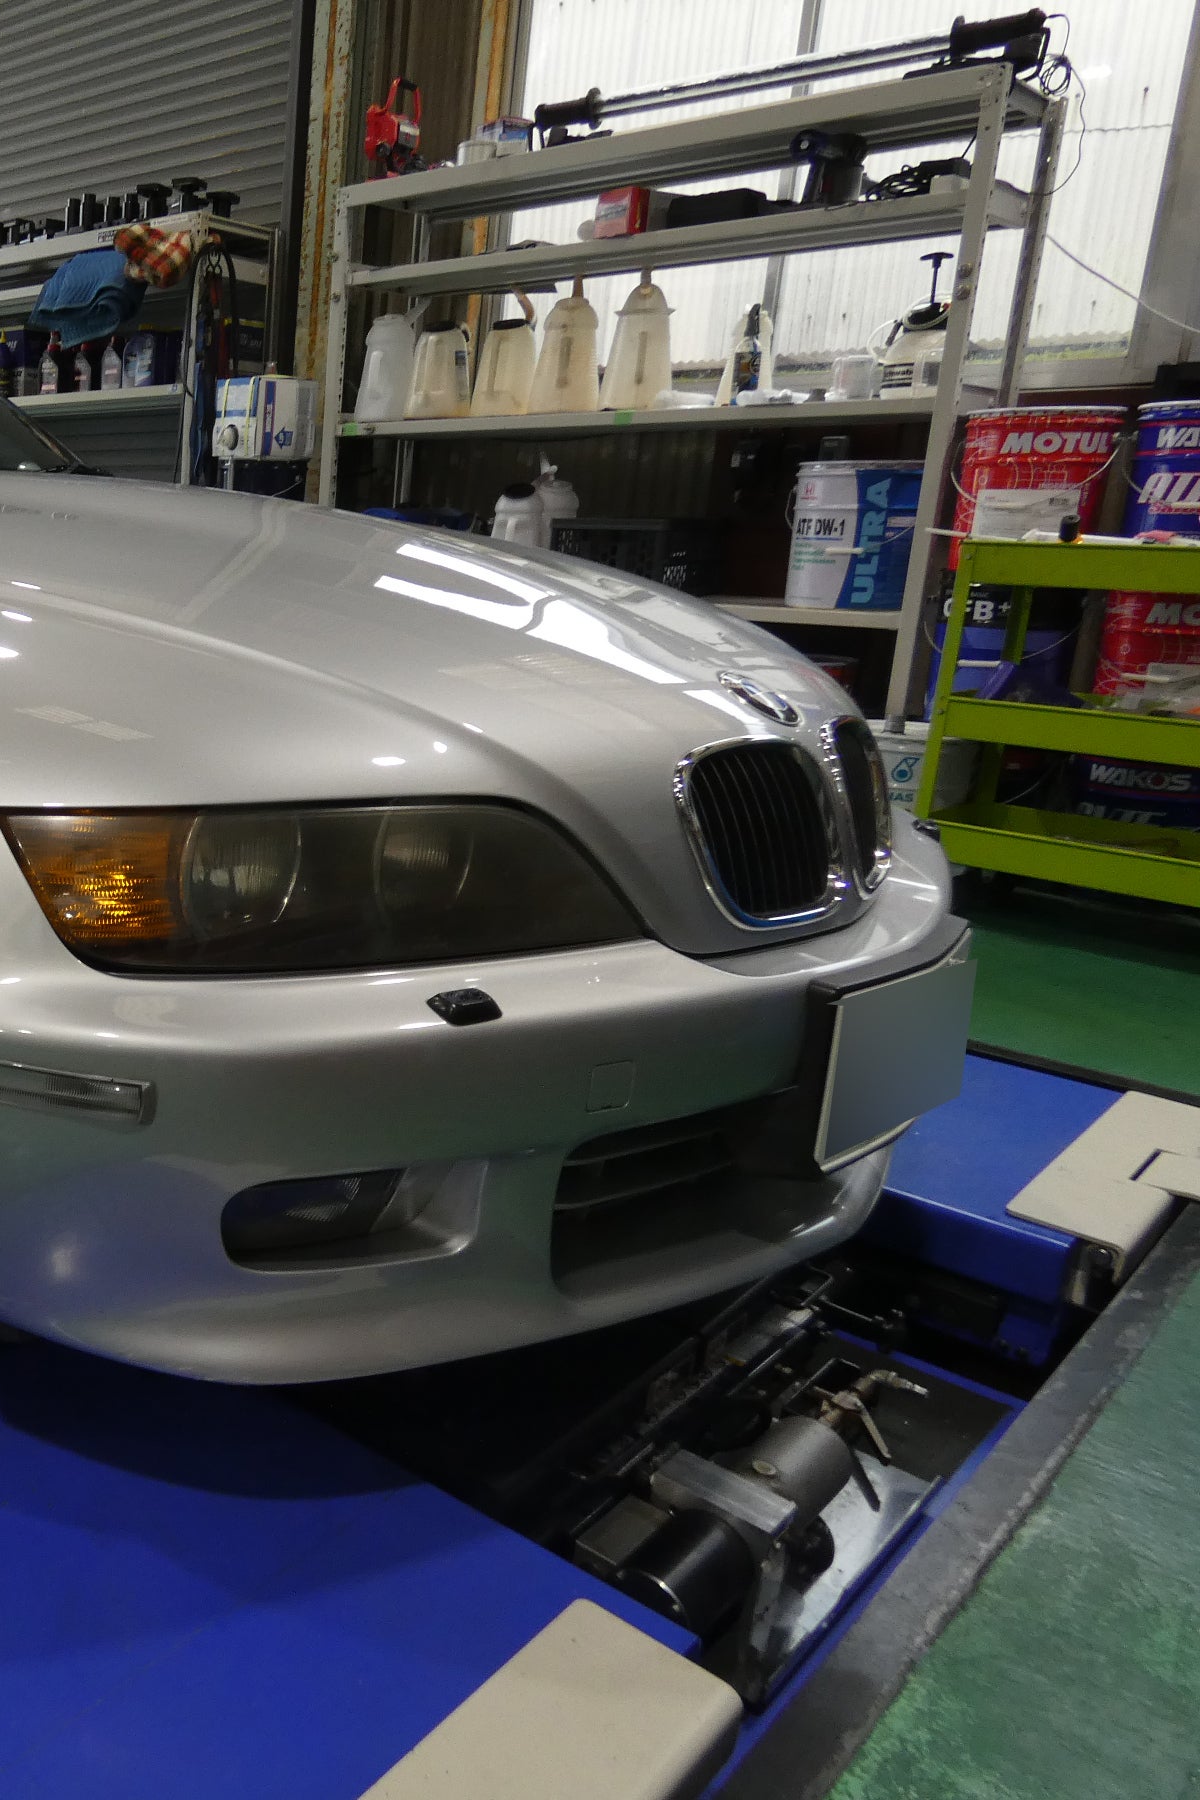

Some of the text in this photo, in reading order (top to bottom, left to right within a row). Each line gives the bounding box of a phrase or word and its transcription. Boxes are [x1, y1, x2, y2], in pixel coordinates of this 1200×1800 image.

[1000, 431, 1109, 454] MOTUL
[796, 518, 846, 536] ATF DW-1
[851, 477, 892, 604] ULTRA
